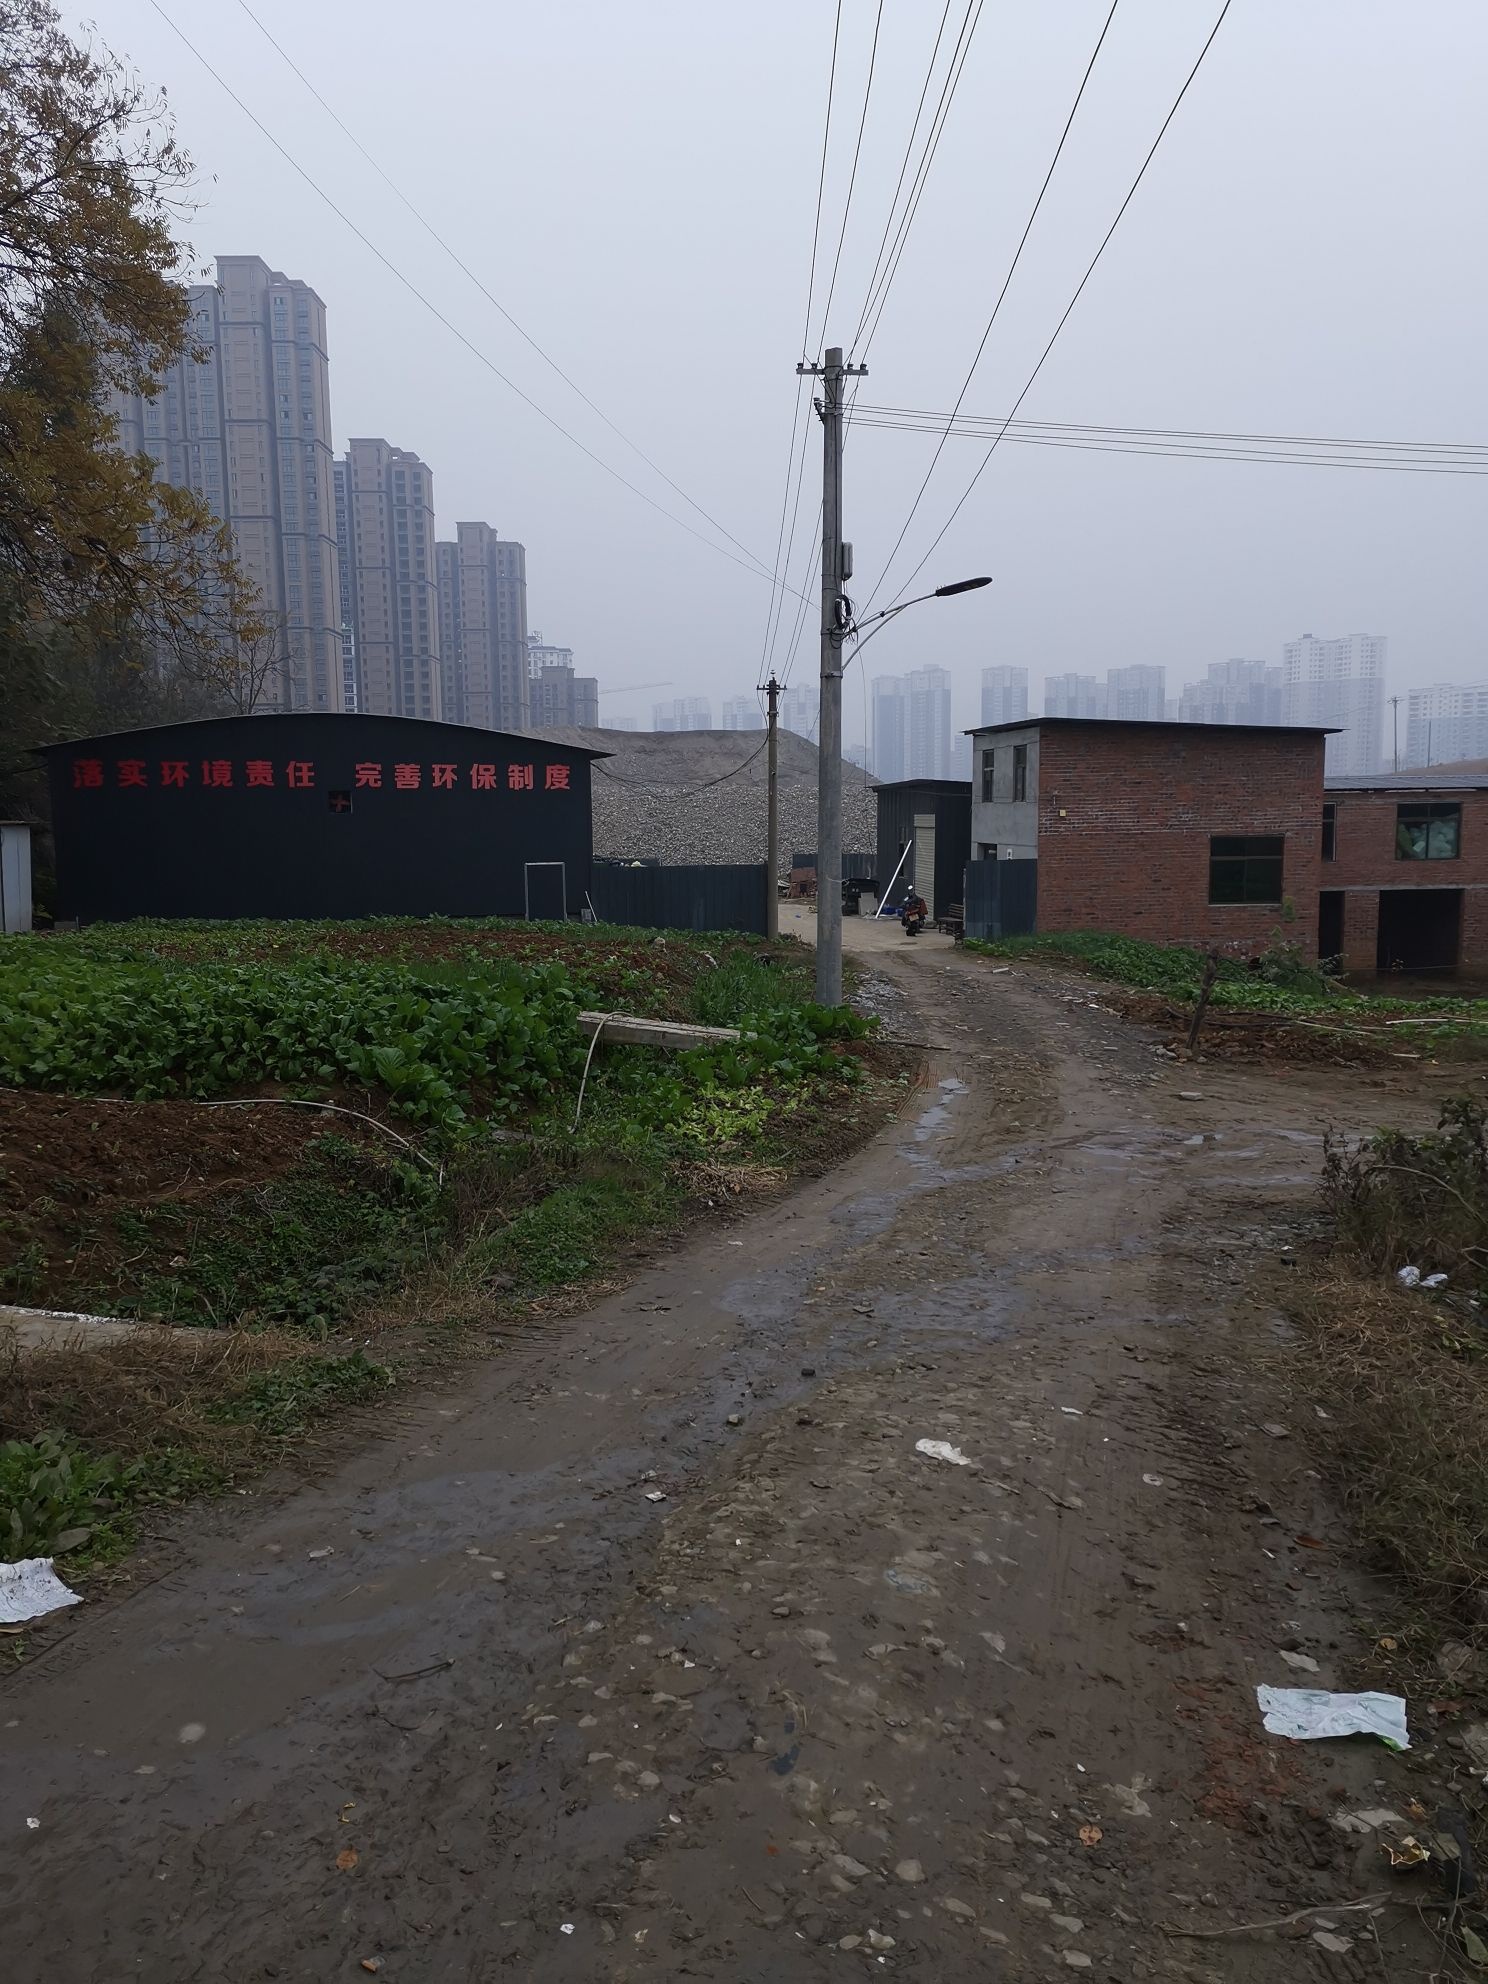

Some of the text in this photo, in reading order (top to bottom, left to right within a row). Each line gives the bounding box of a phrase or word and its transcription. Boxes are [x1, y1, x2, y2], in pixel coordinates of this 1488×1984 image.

[72, 759, 571, 790] 落实环境责任 完善环保制度
